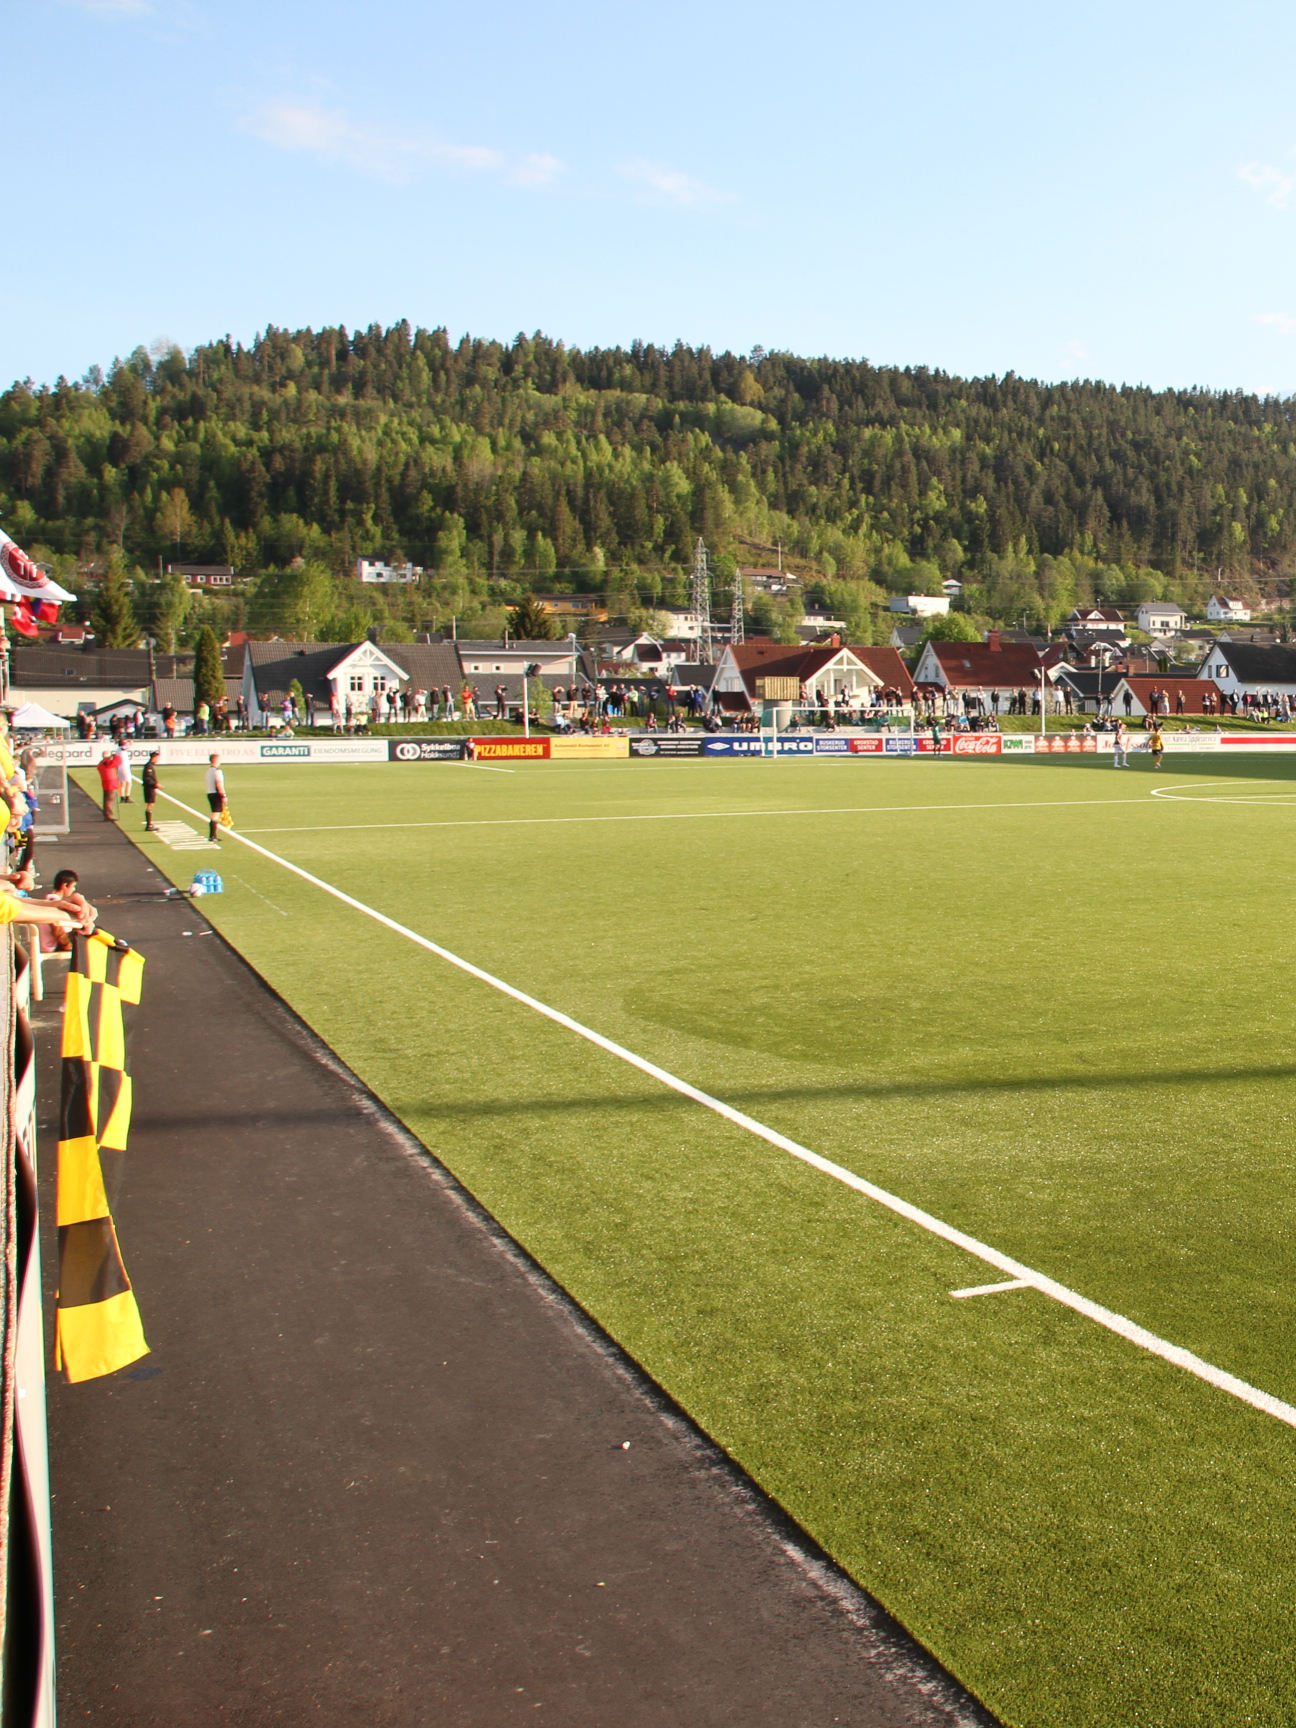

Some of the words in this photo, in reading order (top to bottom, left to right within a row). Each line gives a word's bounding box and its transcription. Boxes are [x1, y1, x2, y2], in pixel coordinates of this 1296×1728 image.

[475, 744, 544, 757] PIZZABAKEREN
[732, 740, 814, 751] UMBRO
[955, 736, 999, 754] Coca-Cola
[1003, 740, 1024, 750] KIWI
[261, 747, 309, 756] GARANTI
